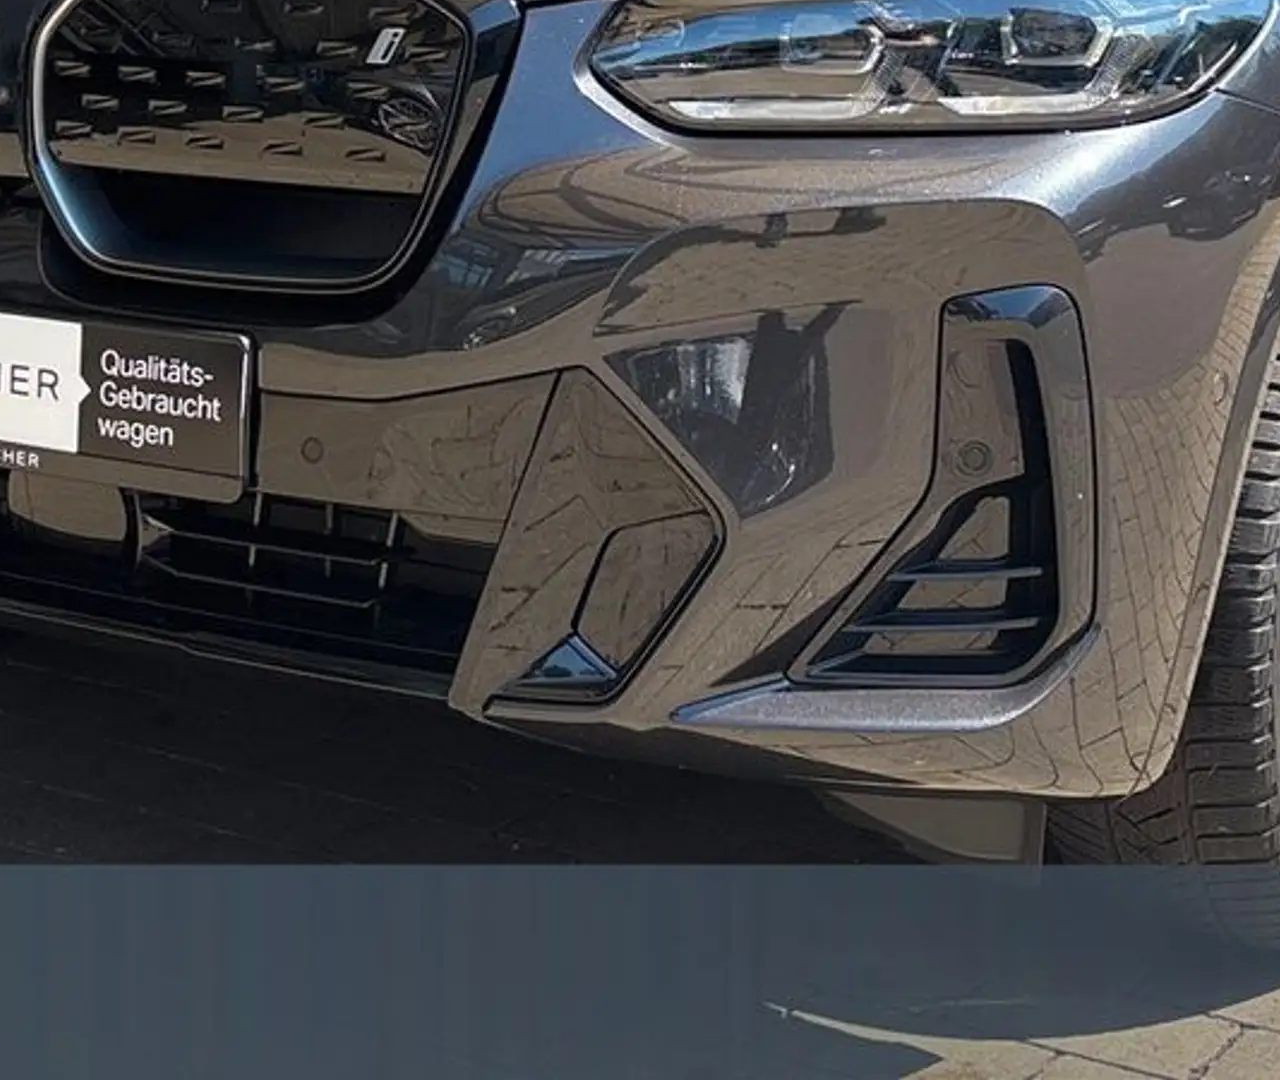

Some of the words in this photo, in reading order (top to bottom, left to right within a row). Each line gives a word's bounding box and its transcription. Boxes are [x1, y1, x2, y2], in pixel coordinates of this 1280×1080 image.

[99, 349, 215, 388] Qualitäts-
[99, 381, 222, 422] Gebraucht
[97, 416, 175, 448] wagen
